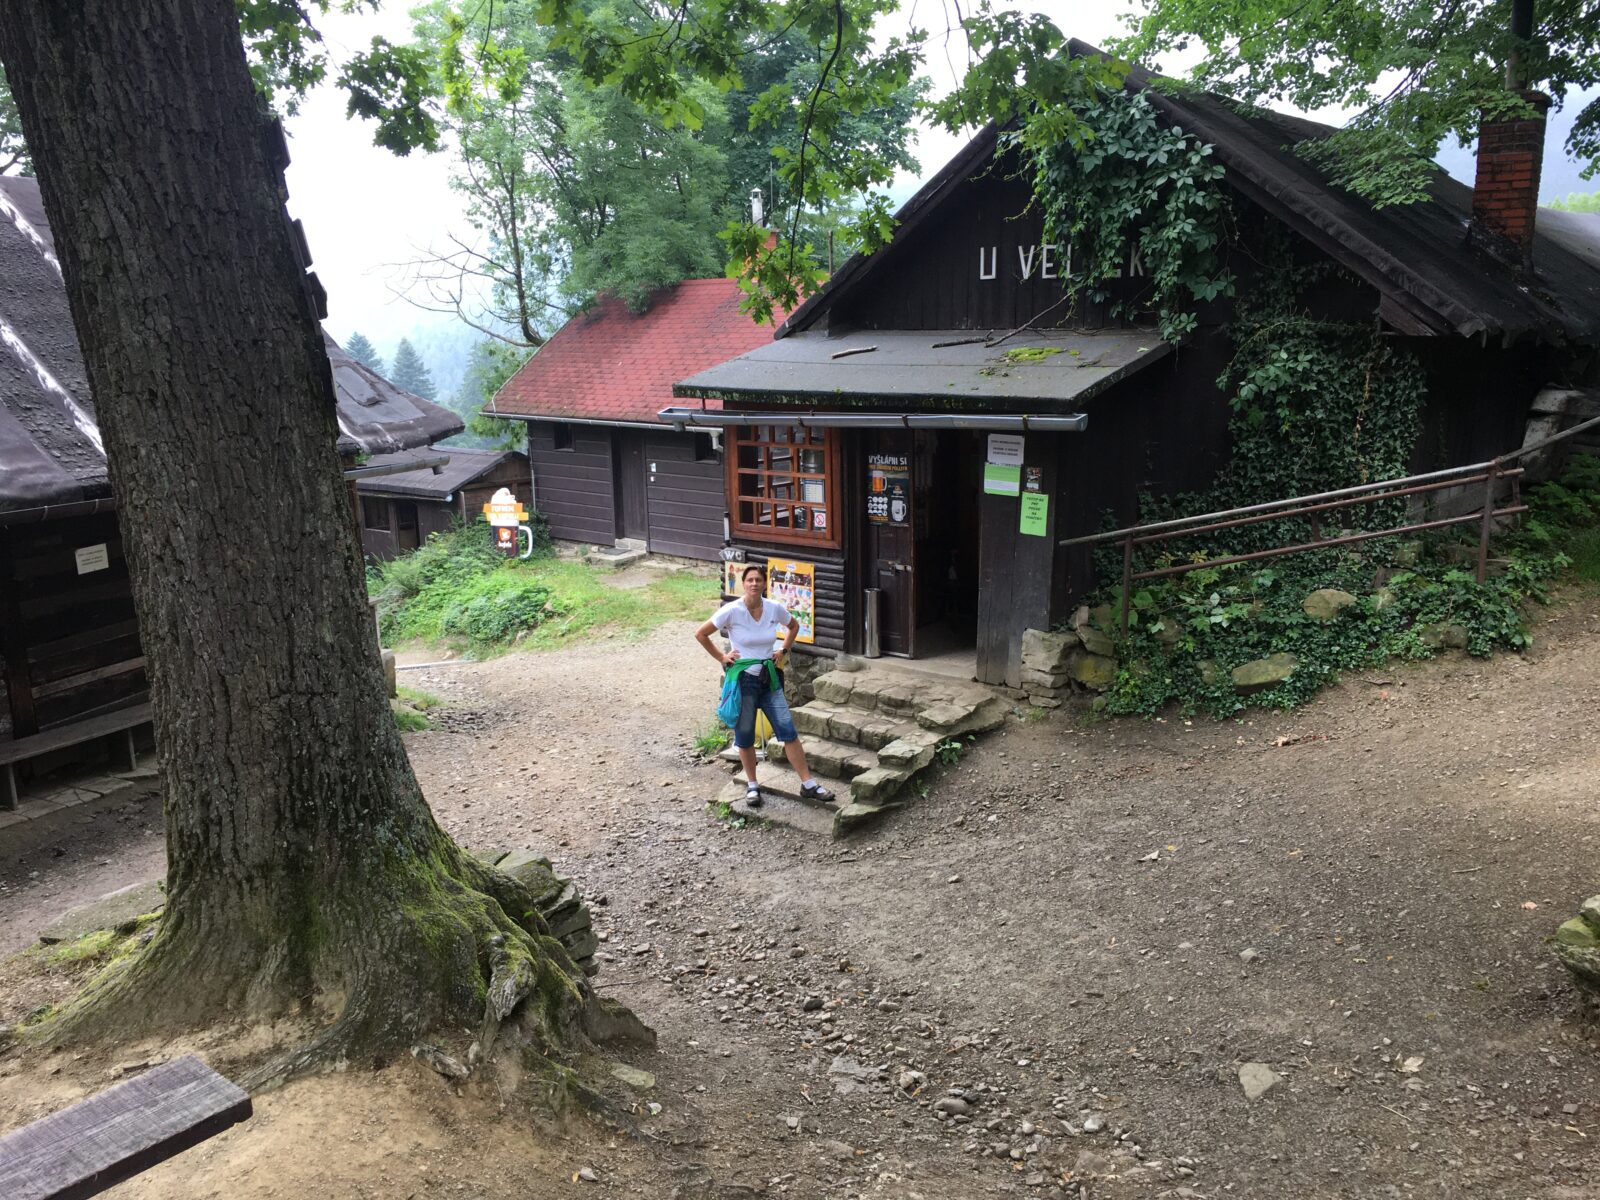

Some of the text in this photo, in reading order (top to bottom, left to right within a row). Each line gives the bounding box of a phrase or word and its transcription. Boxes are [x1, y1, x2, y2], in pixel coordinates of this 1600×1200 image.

[979, 246, 997, 280] U
[899, 457, 907, 465] SI
[724, 550, 742, 560] WC
